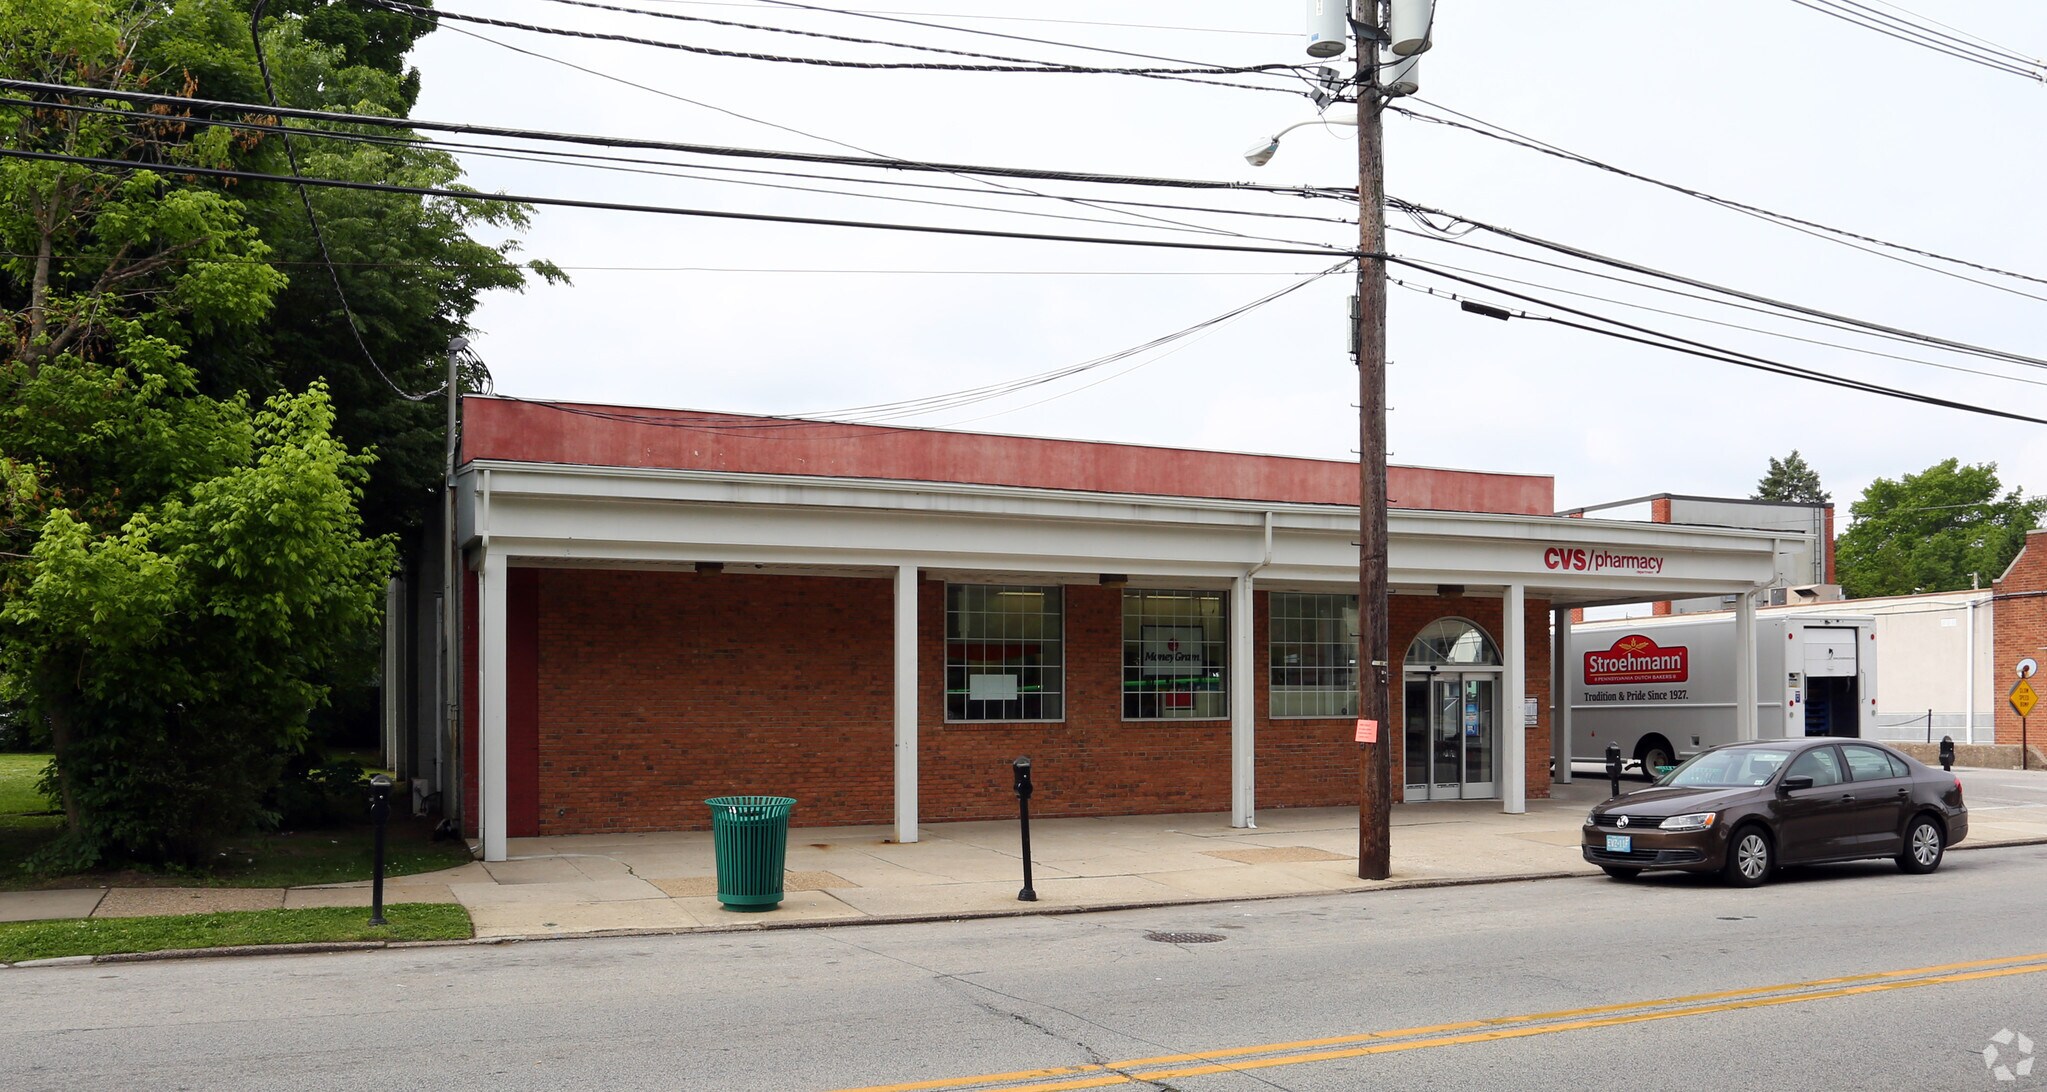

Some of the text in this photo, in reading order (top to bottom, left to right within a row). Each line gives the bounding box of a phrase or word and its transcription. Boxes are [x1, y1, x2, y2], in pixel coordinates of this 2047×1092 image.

[1544, 547, 1664, 574] CVS/pharmacy
[1589, 653, 1681, 673] Stroehmann
[1584, 689, 1689, 702] Tradition & Pride Since 1927.
